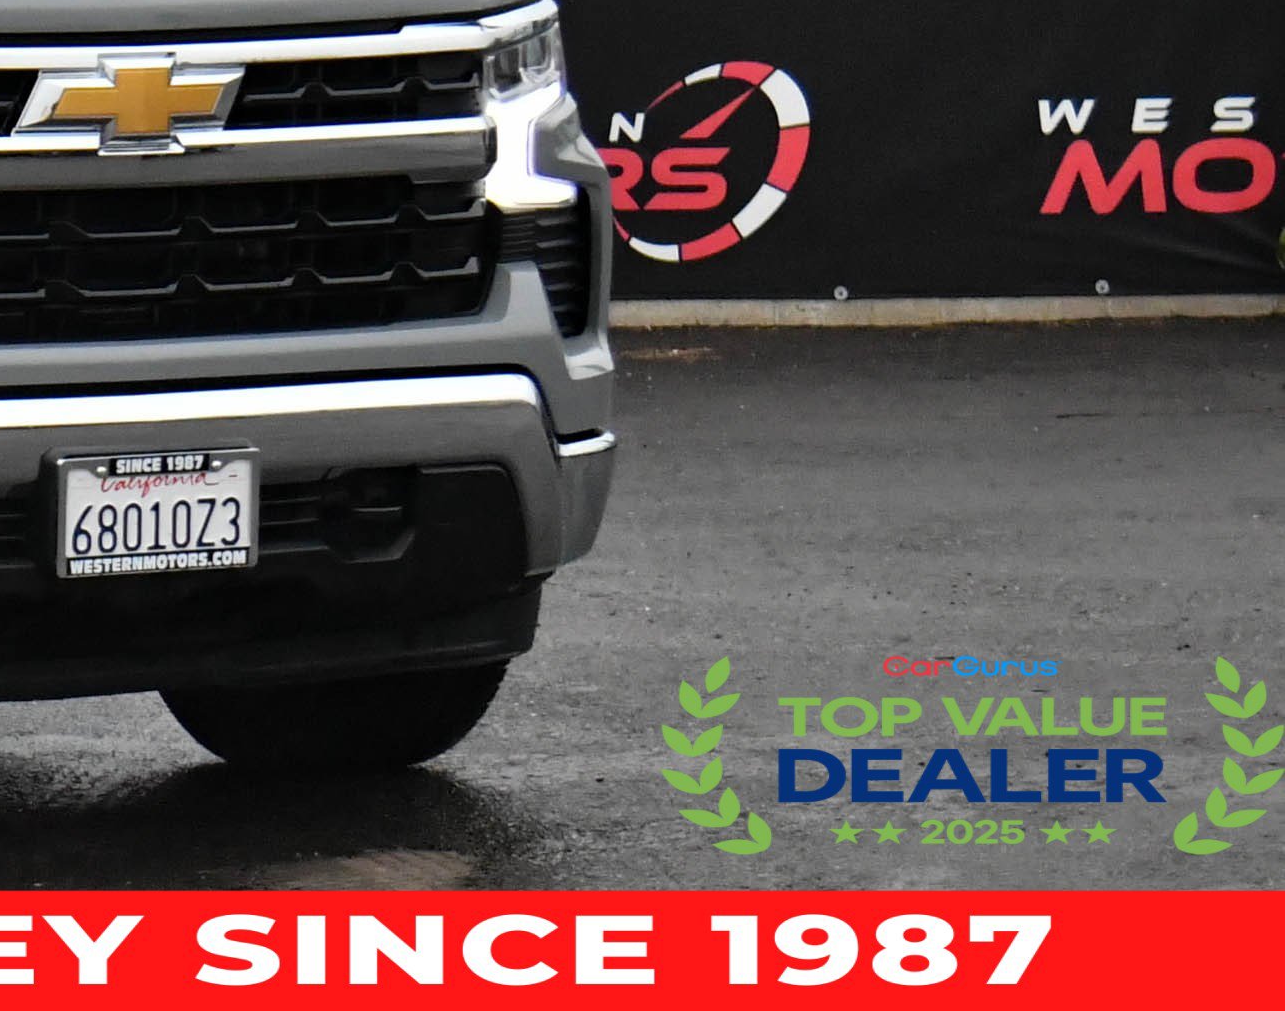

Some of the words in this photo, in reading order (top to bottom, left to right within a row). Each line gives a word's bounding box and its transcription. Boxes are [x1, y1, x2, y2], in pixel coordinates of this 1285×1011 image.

[116, 457, 162, 473] SINCE
[166, 455, 204, 471] 1987
[71, 497, 241, 555] 68010Z3
[70, 549, 247, 575] WESTERNMOTORS.COM
